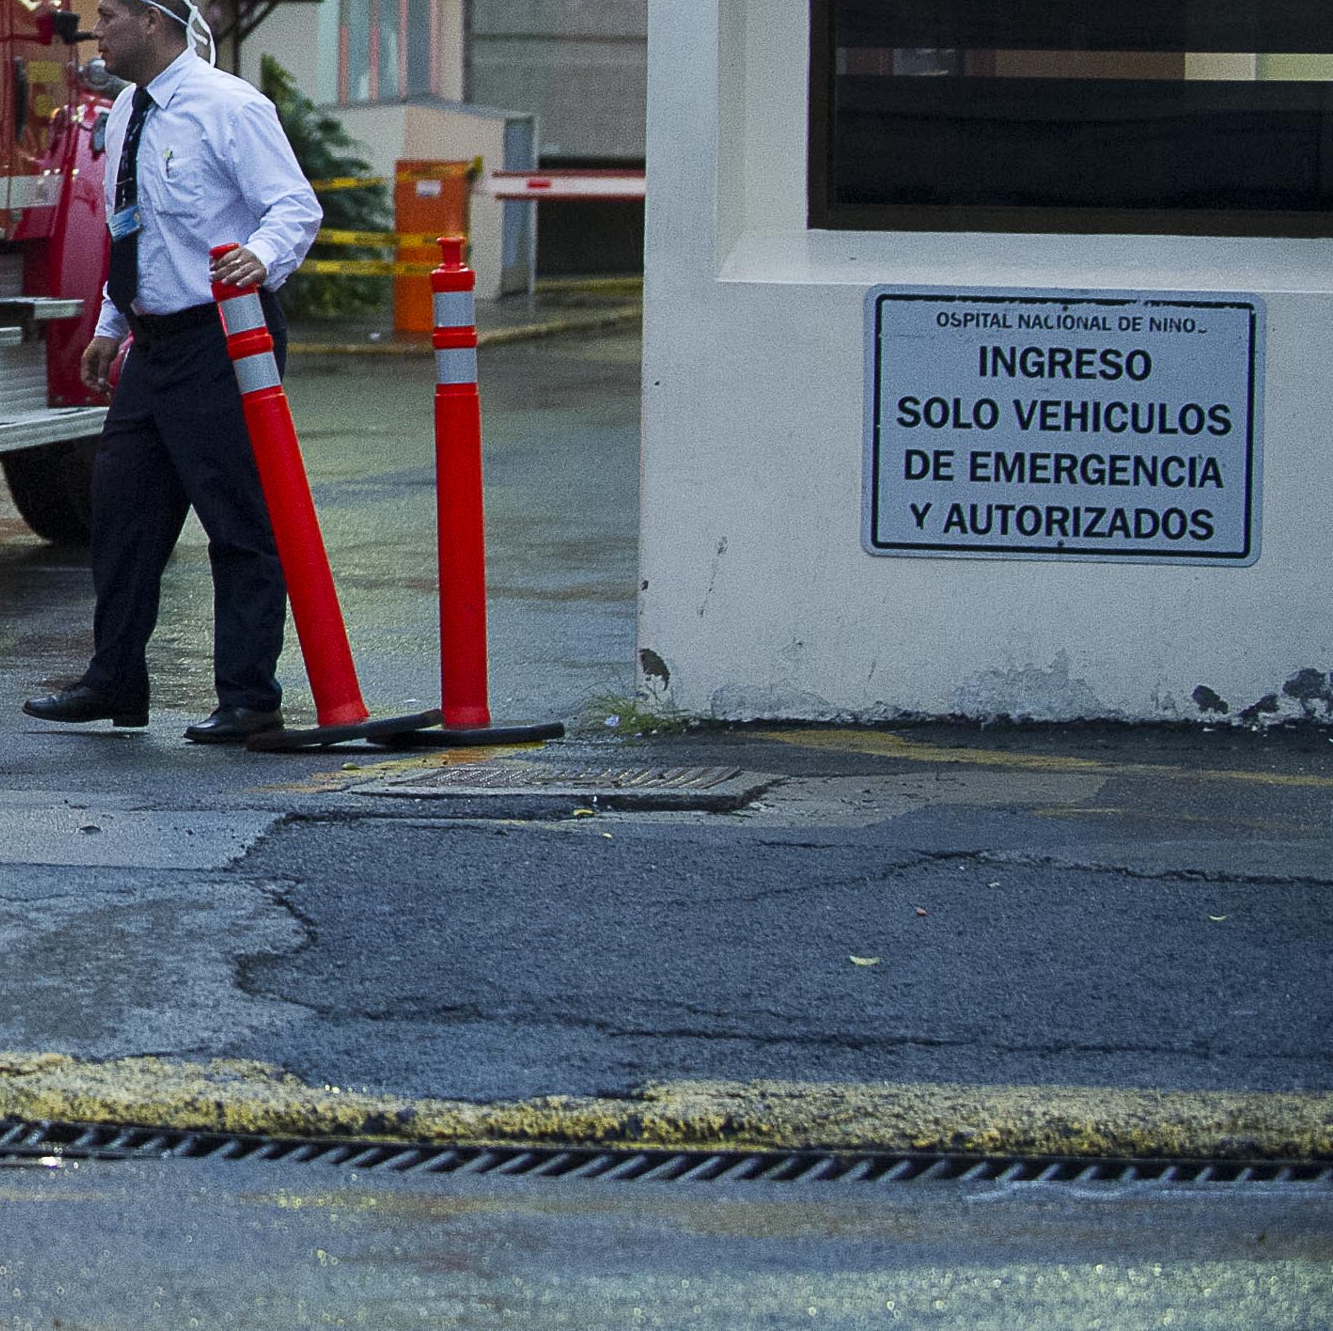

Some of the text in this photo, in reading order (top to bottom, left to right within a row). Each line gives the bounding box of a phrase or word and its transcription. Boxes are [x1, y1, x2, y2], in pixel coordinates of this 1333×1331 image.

[1018, 313, 1111, 332] NACIONAL
[1118, 316, 1141, 332] DE
[1149, 317, 1207, 334] NINO
[979, 345, 1152, 381] INGRESO
[896, 396, 1232, 436] SOLO VEHICULOS
[904, 449, 1224, 488] DE EMERGENCIA
[909, 502, 1214, 540] Y AUTORIZADOS
